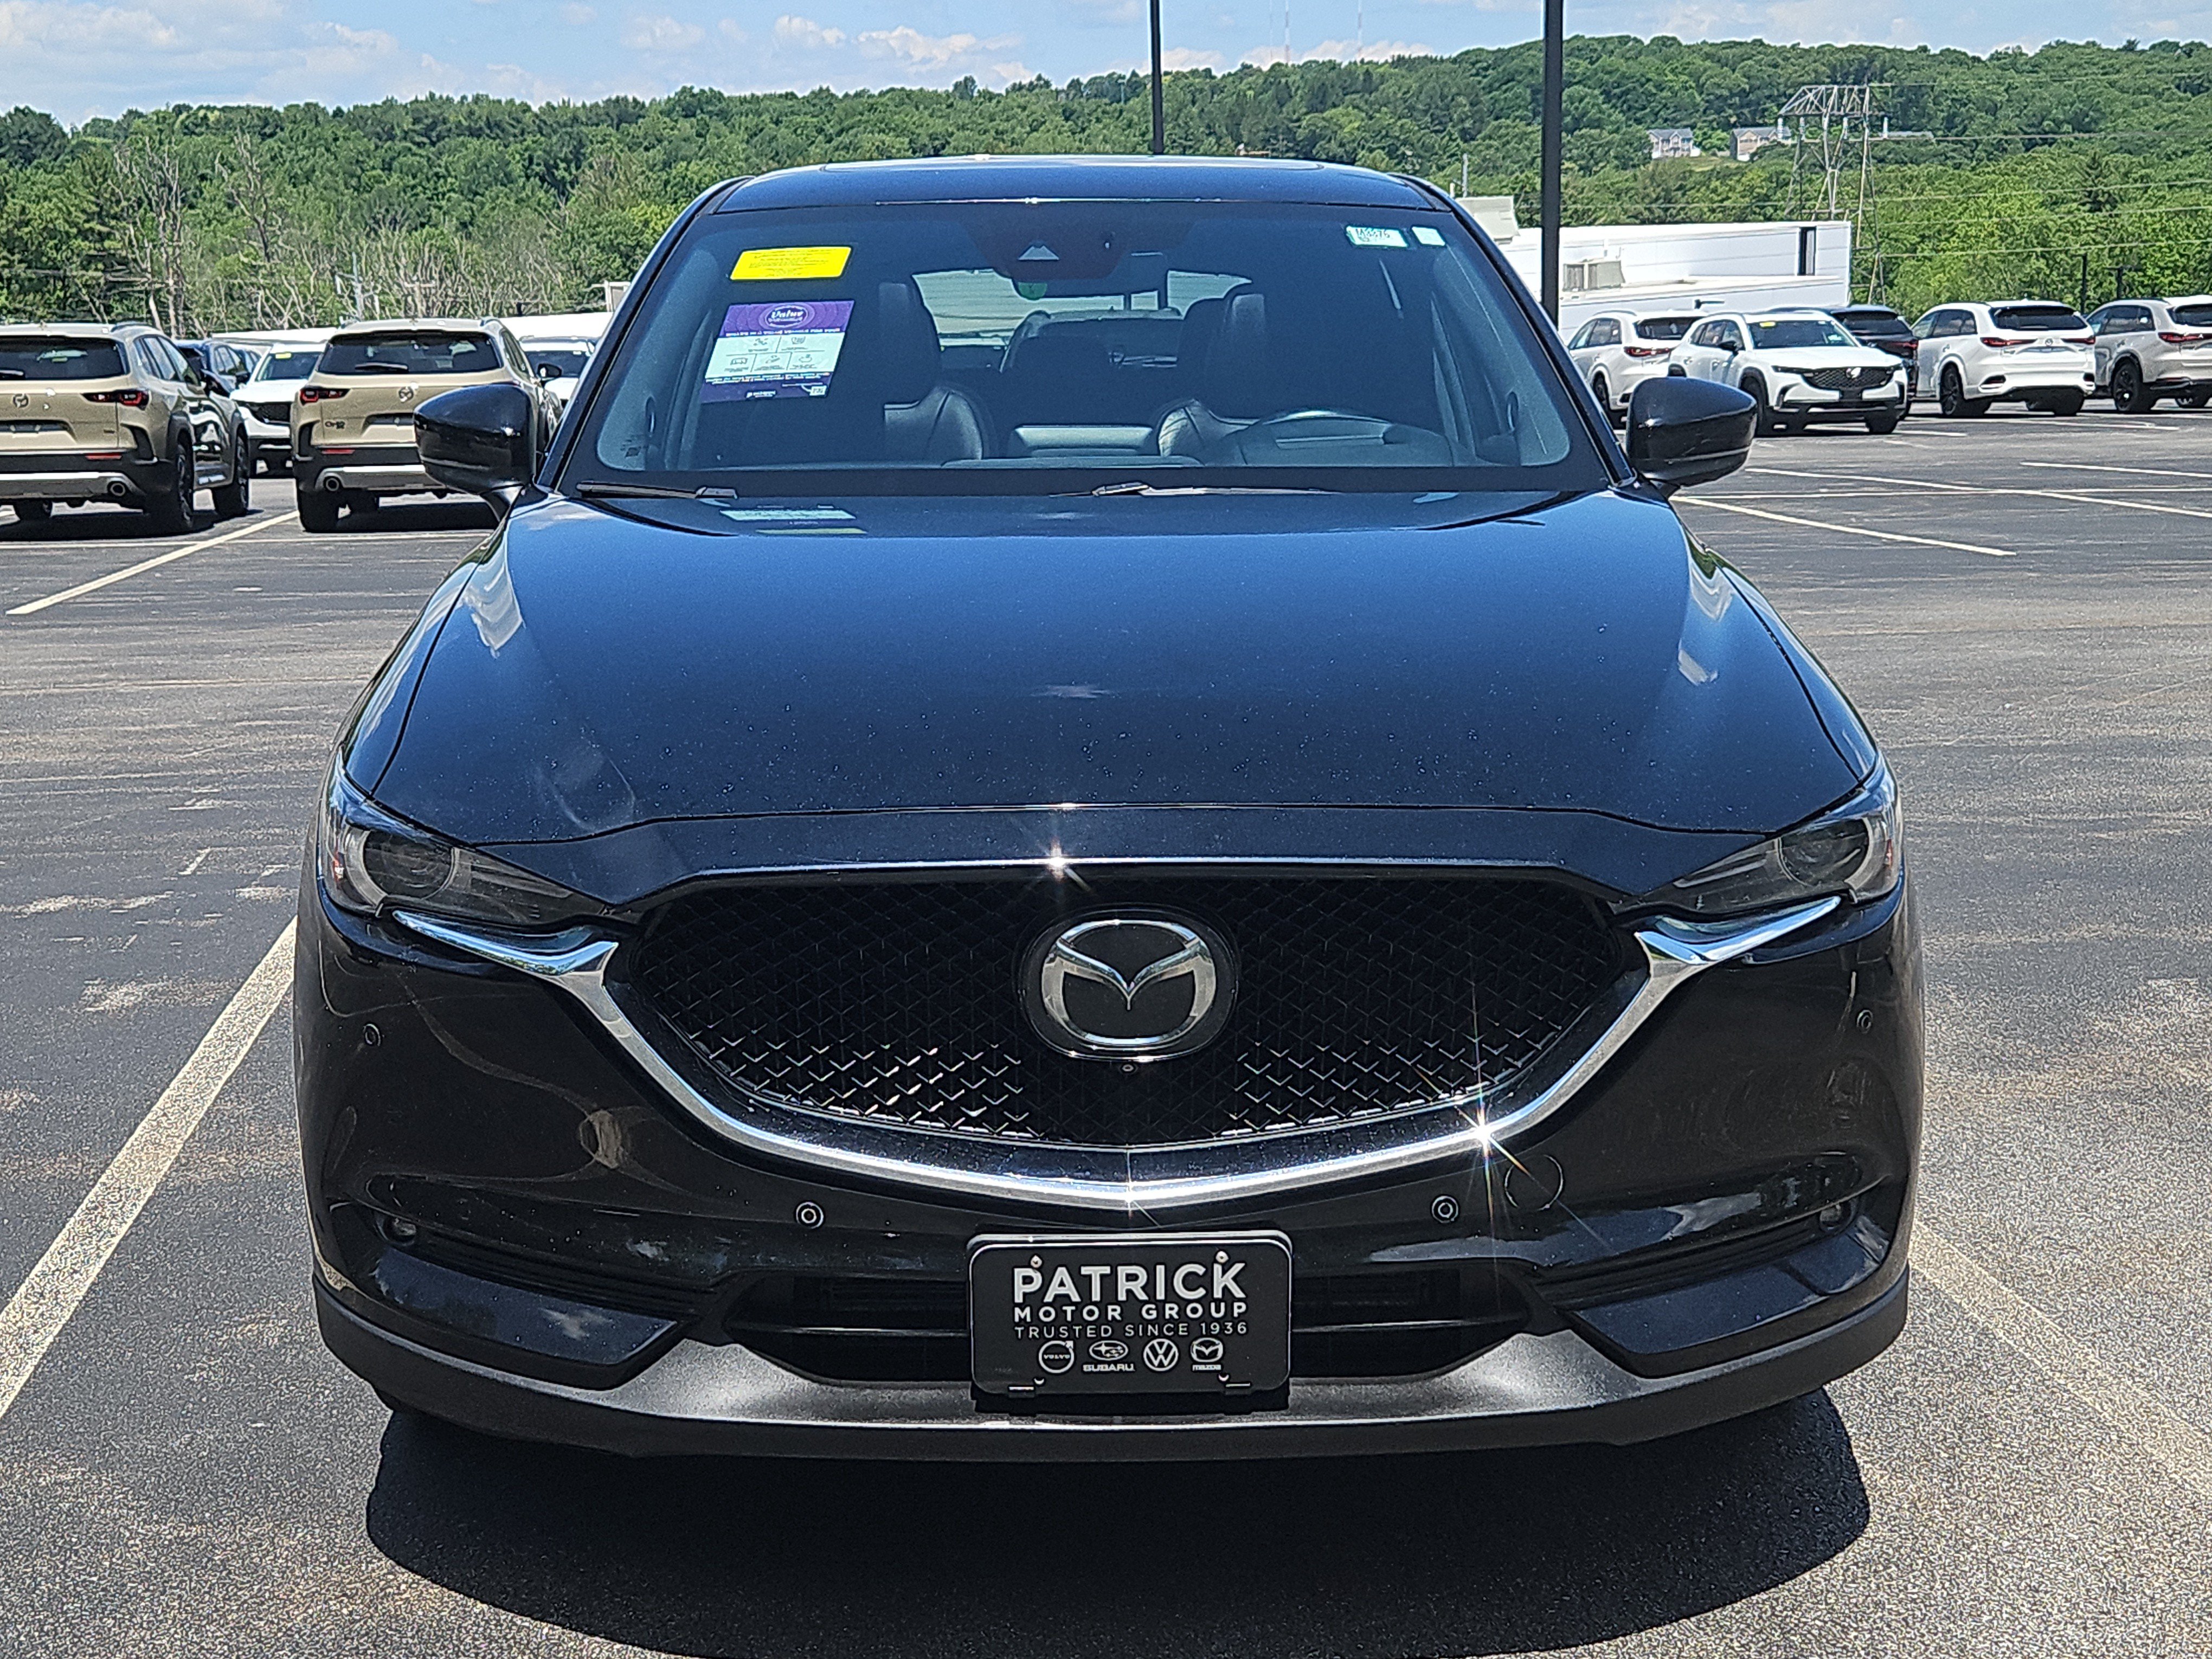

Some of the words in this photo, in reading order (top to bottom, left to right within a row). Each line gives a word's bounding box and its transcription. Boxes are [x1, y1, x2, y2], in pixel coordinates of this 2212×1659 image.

[1014, 1263, 1246, 1303] PATRICK
[1014, 1306, 1122, 1322] MOTOR
[1141, 1302, 1246, 1319] GROUP
[1015, 1326, 1112, 1339] TRUSTED
[1125, 1323, 1188, 1336] SINCE
[1200, 1322, 1246, 1334] 1936
[1083, 1364, 1134, 1372] SUBARU
